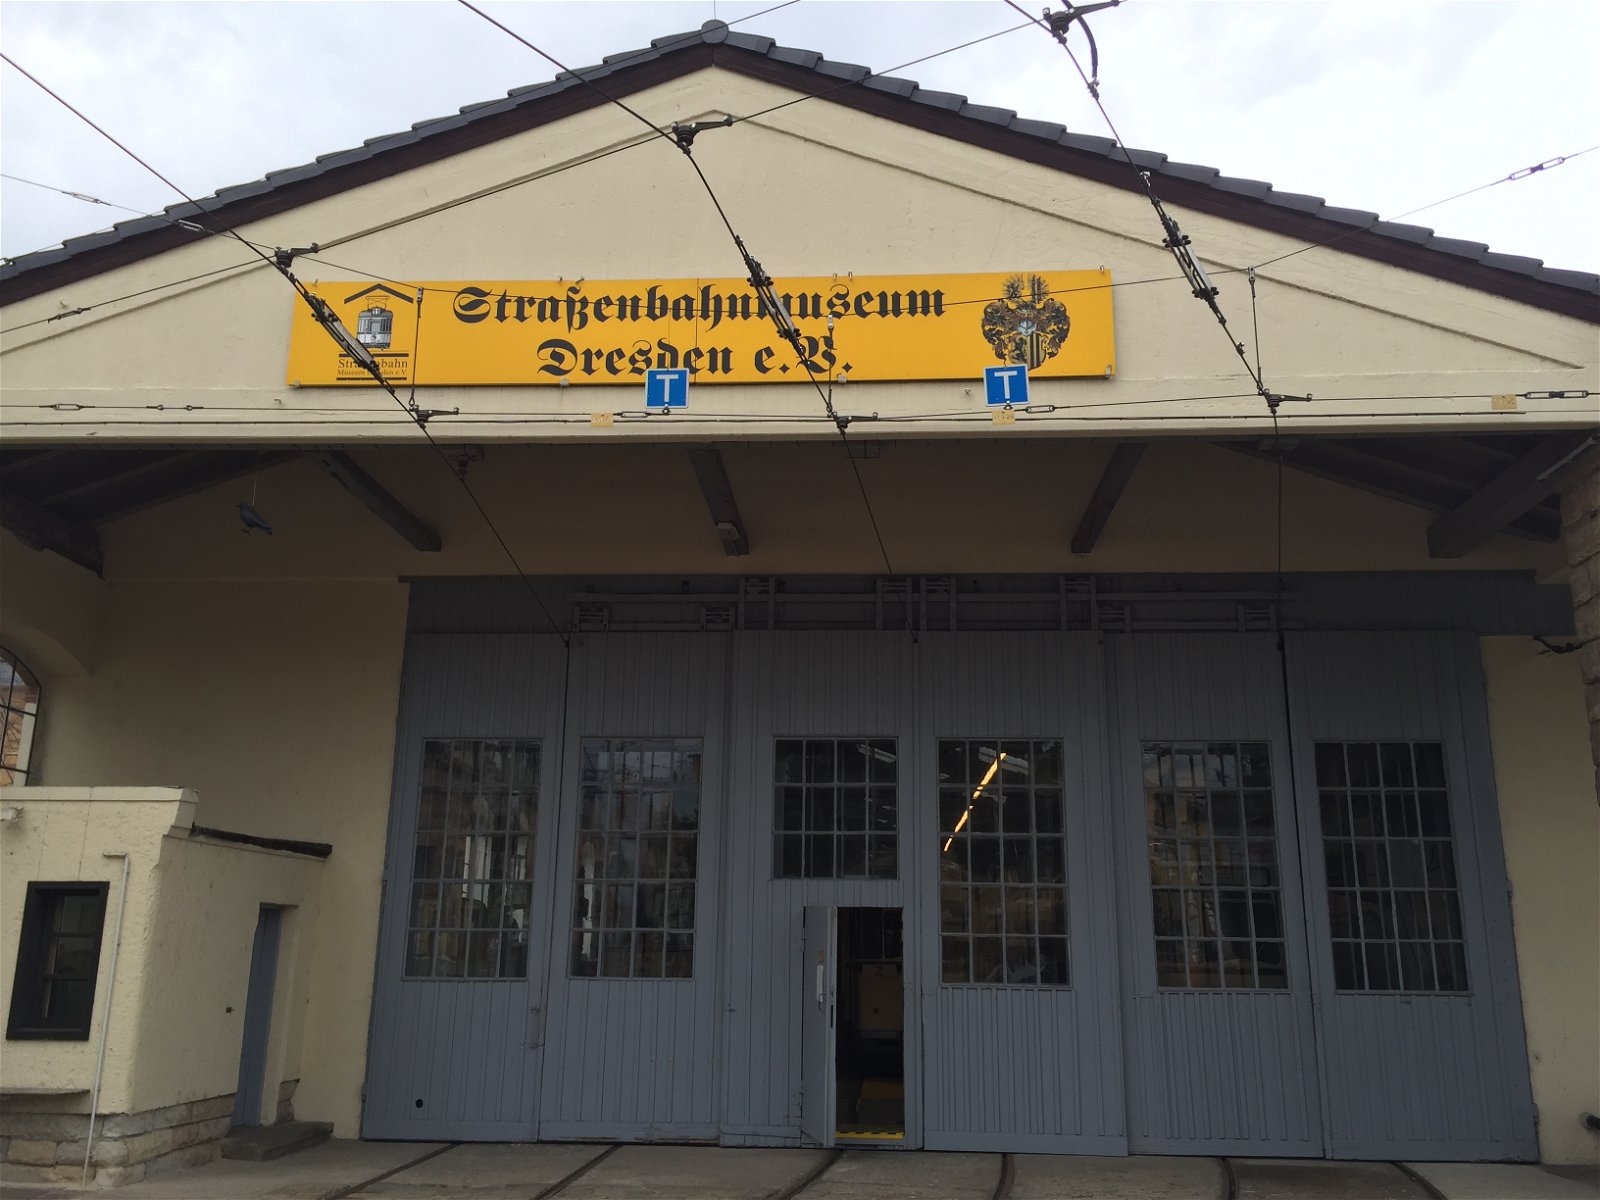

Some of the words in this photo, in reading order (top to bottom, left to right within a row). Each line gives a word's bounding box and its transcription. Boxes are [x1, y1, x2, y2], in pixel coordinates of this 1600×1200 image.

[537, 337, 734, 376] Dresden
[656, 374, 679, 402] T
[994, 371, 1018, 399] T
